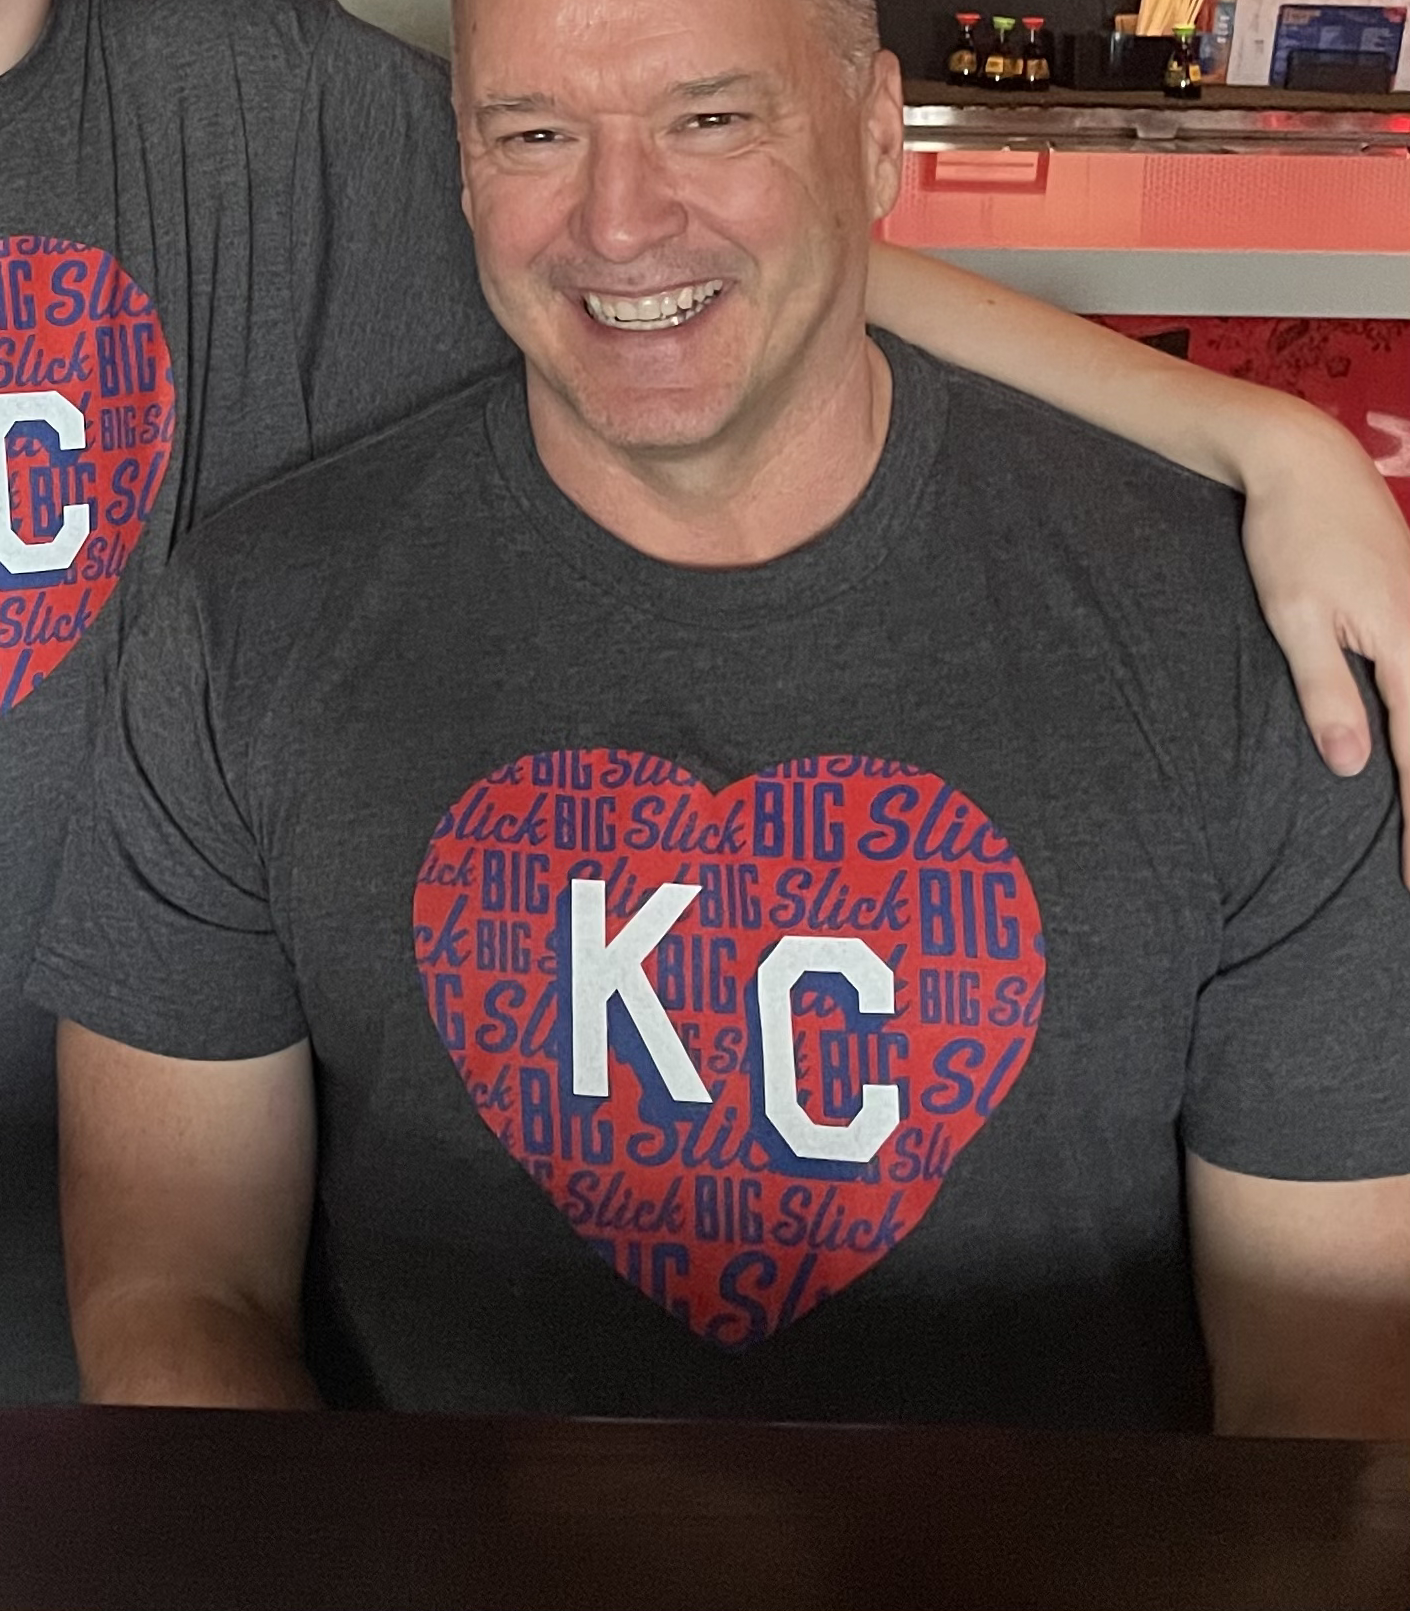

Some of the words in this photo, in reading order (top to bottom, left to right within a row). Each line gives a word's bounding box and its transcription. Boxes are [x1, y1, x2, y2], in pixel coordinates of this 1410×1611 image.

[45, 251, 157, 327] Slic
[96, 323, 157, 398] BIG
[101, 405, 137, 452] BIG
[435, 786, 548, 846] lick
[555, 793, 616, 852] BIG
[624, 794, 746, 855] Slick
[753, 782, 845, 862] BIG
[857, 784, 1016, 864] Slic
[481, 849, 550, 914] BIG
[699, 863, 762, 929] BIG
[769, 867, 911, 931] Slick
[919, 867, 1020, 960] BIG
[477, 918, 531, 973] BIG
[656, 932, 737, 1013] BIG
[919, 968, 981, 1026] BIG
[561, 1170, 685, 1234] Slick
[695, 1174, 764, 1244] BIG
[770, 1185, 906, 1253] Slick
